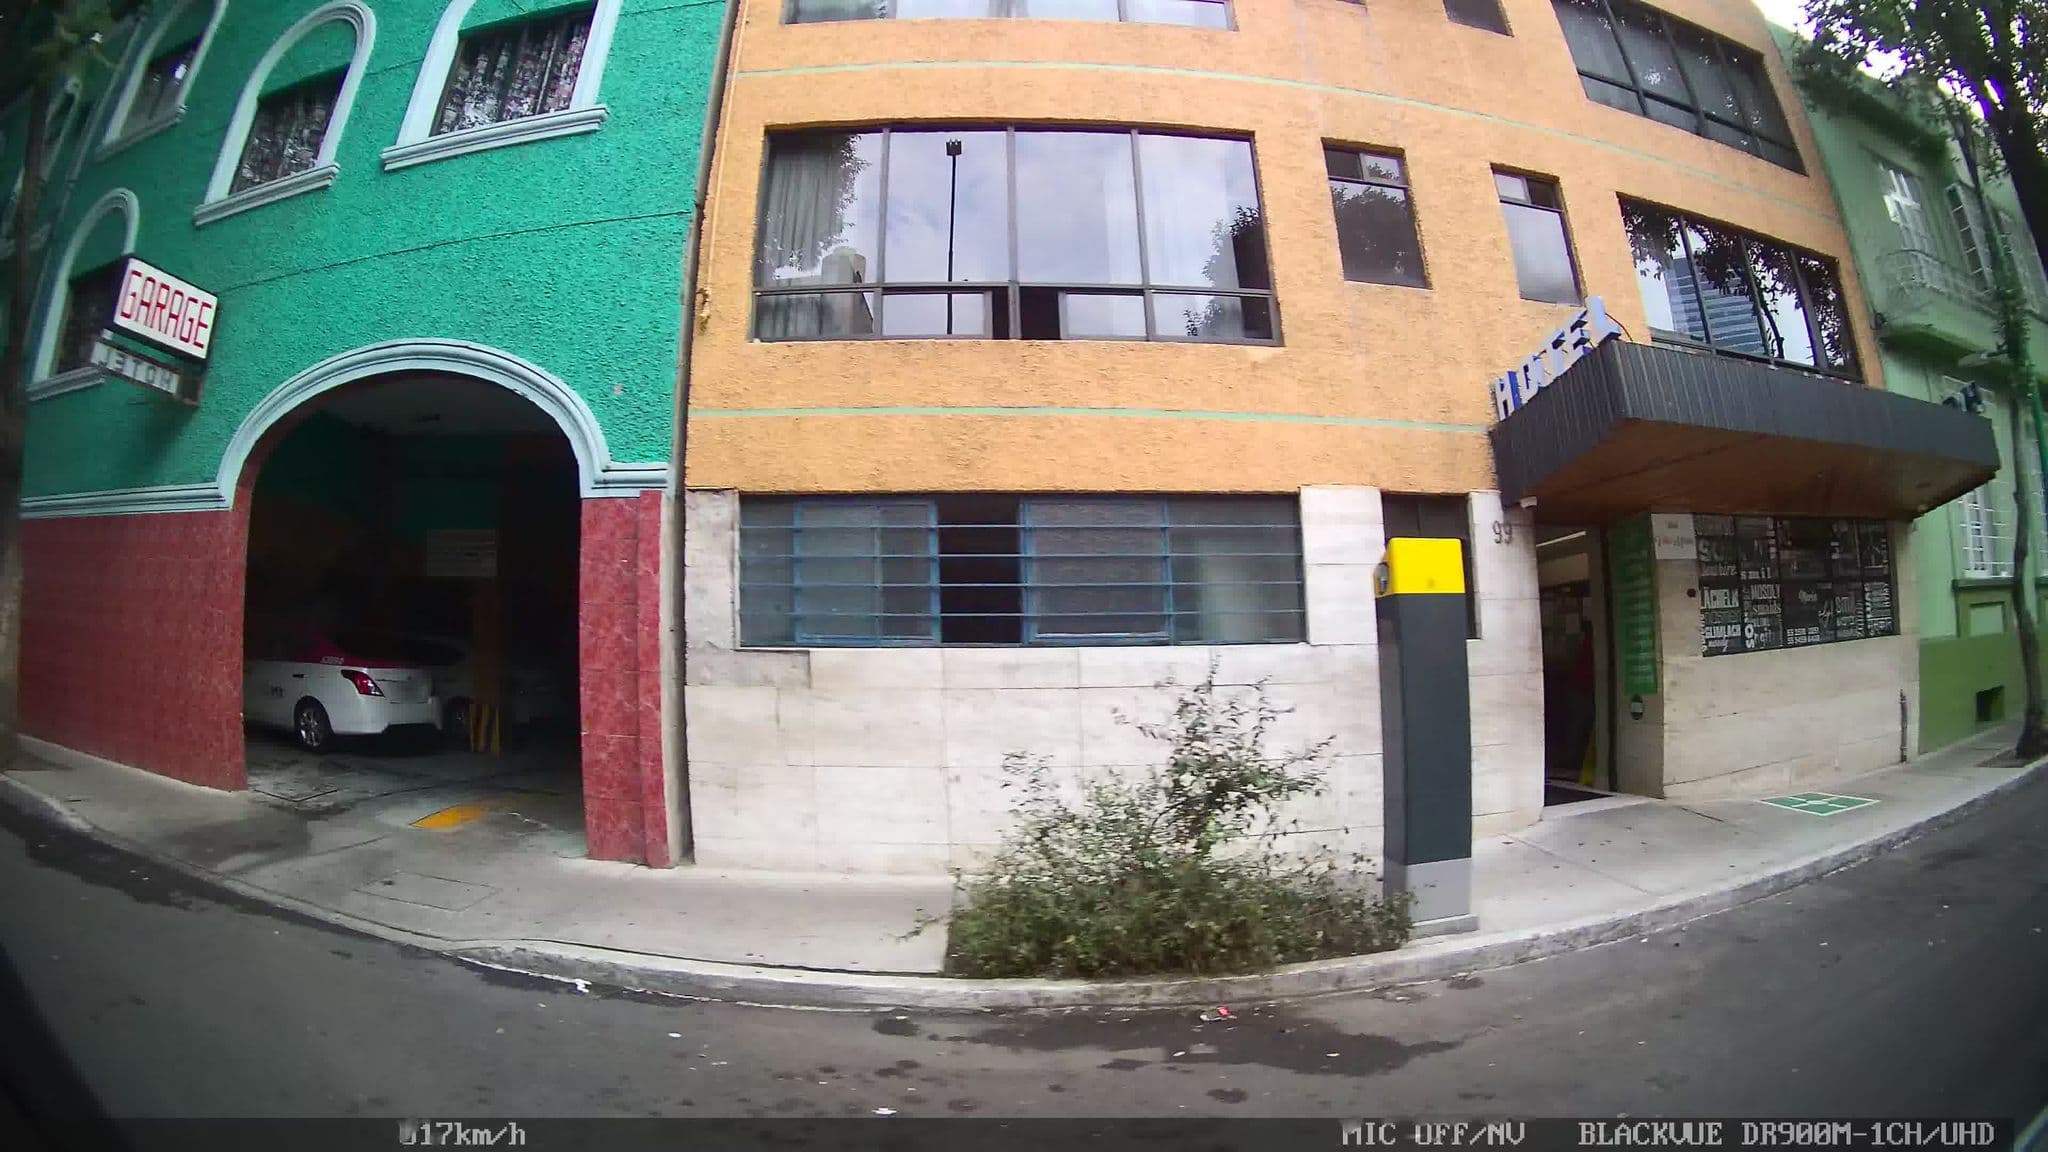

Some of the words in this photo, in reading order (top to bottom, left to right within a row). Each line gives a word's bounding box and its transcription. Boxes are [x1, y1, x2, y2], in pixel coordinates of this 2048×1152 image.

[120, 270, 212, 349] GARAGE
[1494, 296, 1621, 421] HOTEL
[1492, 520, 1513, 545] 99
